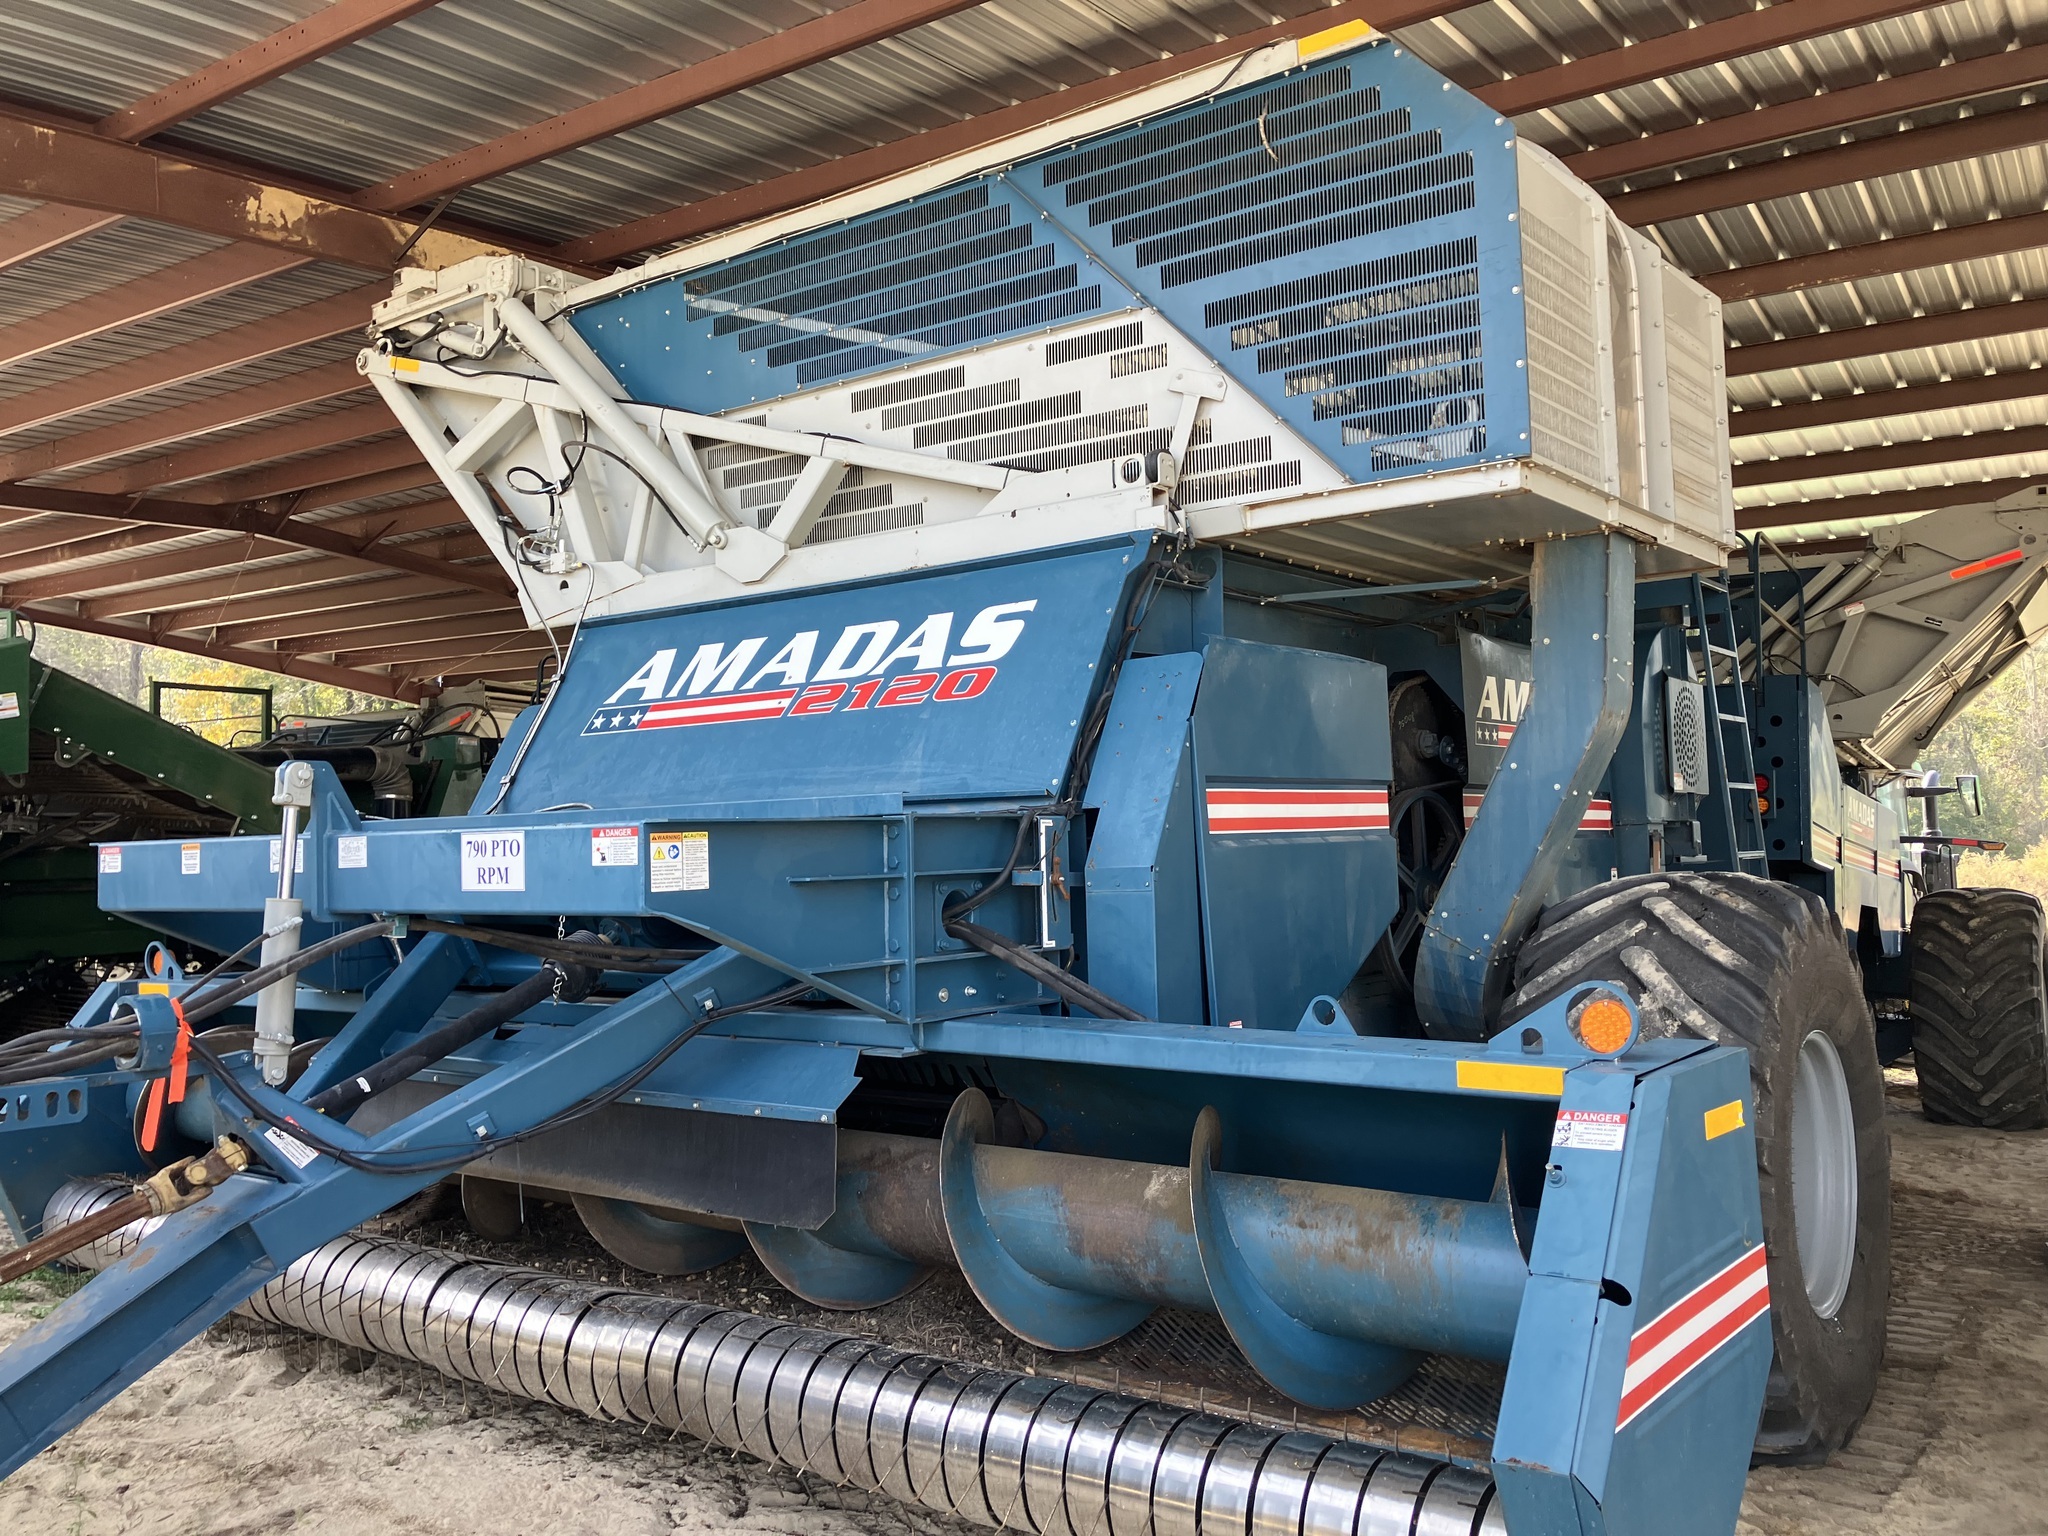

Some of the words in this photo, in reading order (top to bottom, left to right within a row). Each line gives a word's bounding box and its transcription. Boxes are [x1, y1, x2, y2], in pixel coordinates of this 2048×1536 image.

[603, 599, 1038, 704] AMADAS
[787, 666, 997, 717] 2120
[605, 828, 632, 837] DANGER
[466, 840, 487, 858] 790
[491, 839, 520, 857] PTO
[477, 867, 509, 884] RPM
[1573, 1112, 1621, 1122] DANGER
